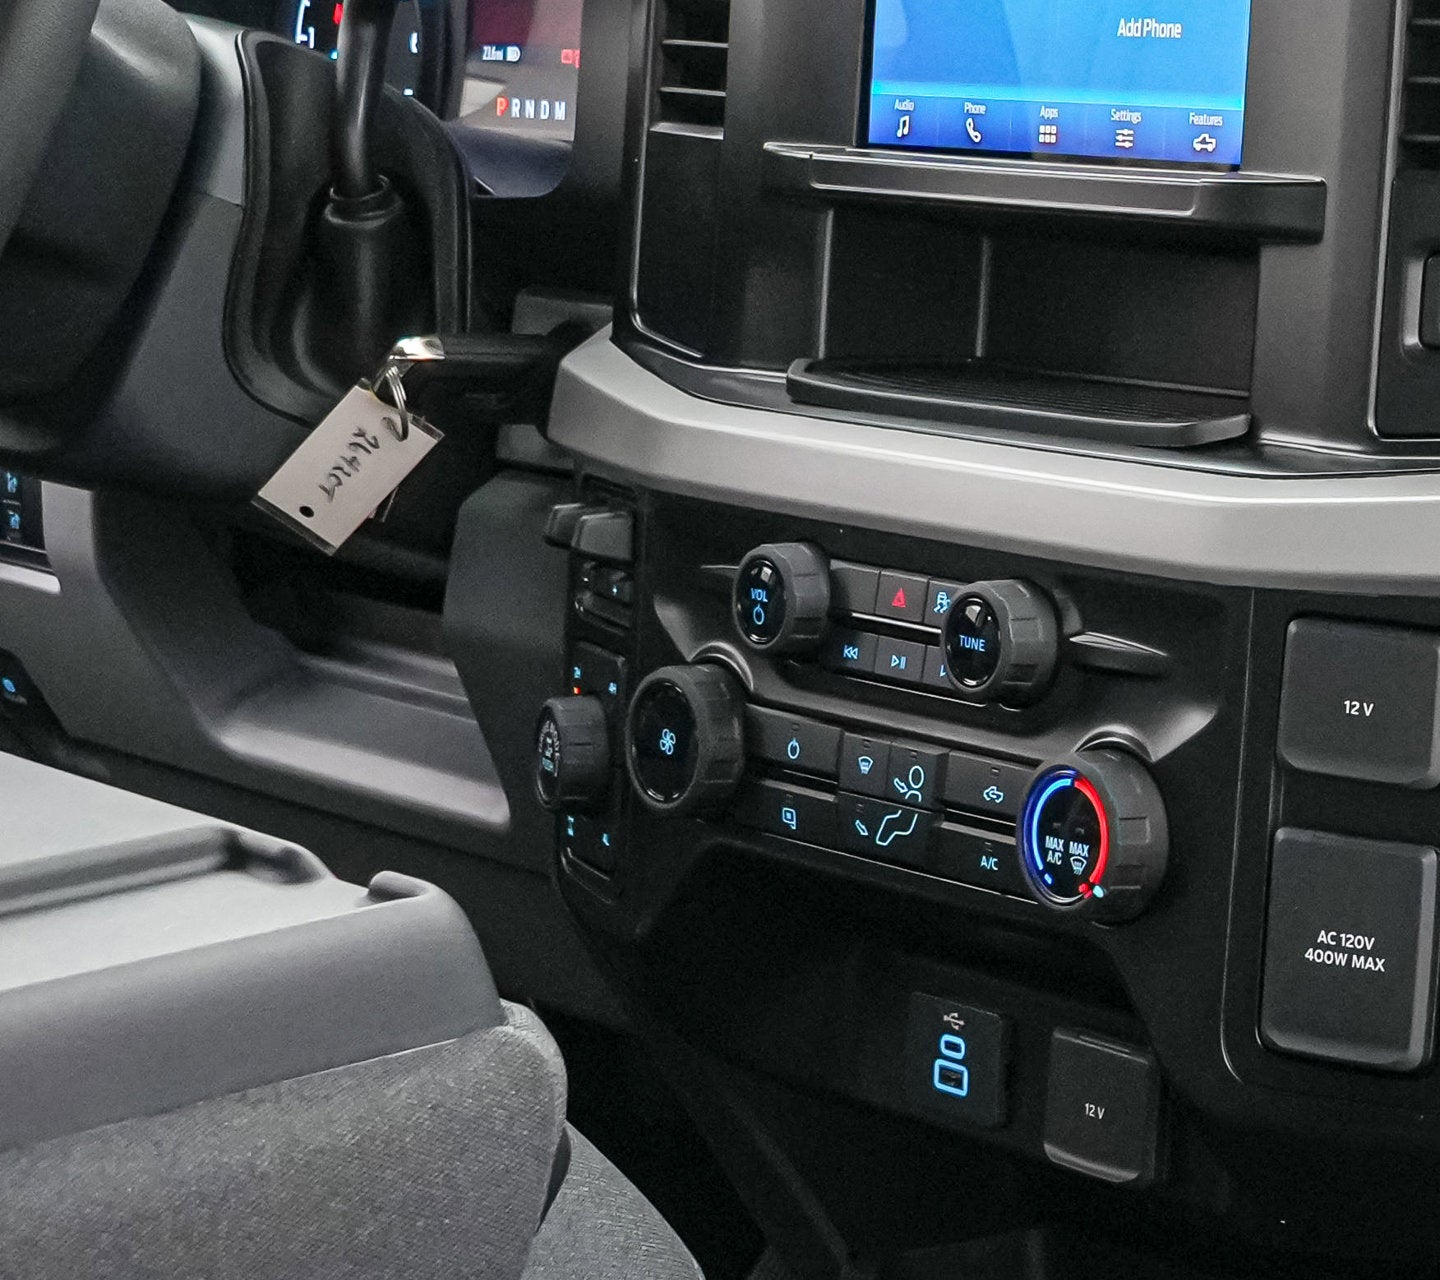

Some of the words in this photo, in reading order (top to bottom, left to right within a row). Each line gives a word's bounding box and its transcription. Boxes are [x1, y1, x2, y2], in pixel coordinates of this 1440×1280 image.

[1117, 18, 1141, 37] Add
[1143, 19, 1182, 39] Phone
[497, 97, 508, 117] P
[512, 98, 521, 118] R
[524, 99, 535, 119] N
[540, 100, 550, 120] D
[555, 101, 566, 120] M
[894, 99, 915, 111] Audio
[964, 102, 987, 115] Phone
[1039, 106, 1059, 119] Apps
[1110, 109, 1142, 124] Settings
[1189, 112, 1223, 127] Features
[751, 588, 768, 603] VOL
[959, 634, 986, 652] TUNE
[1344, 700, 1360, 715] 12
[1363, 702, 1374, 716] V
[1045, 835, 1065, 852] MAX
[1069, 841, 1089, 857] MAX
[980, 855, 999, 871] A/C
[1046, 850, 1062, 865] A/C
[1317, 929, 1337, 945] AC
[1339, 933, 1375, 951] 120V
[1304, 947, 1348, 967] 400W
[1351, 954, 1385, 972] MAX
[1085, 1103, 1095, 1117] 12
[1097, 1106, 1104, 1119] V
